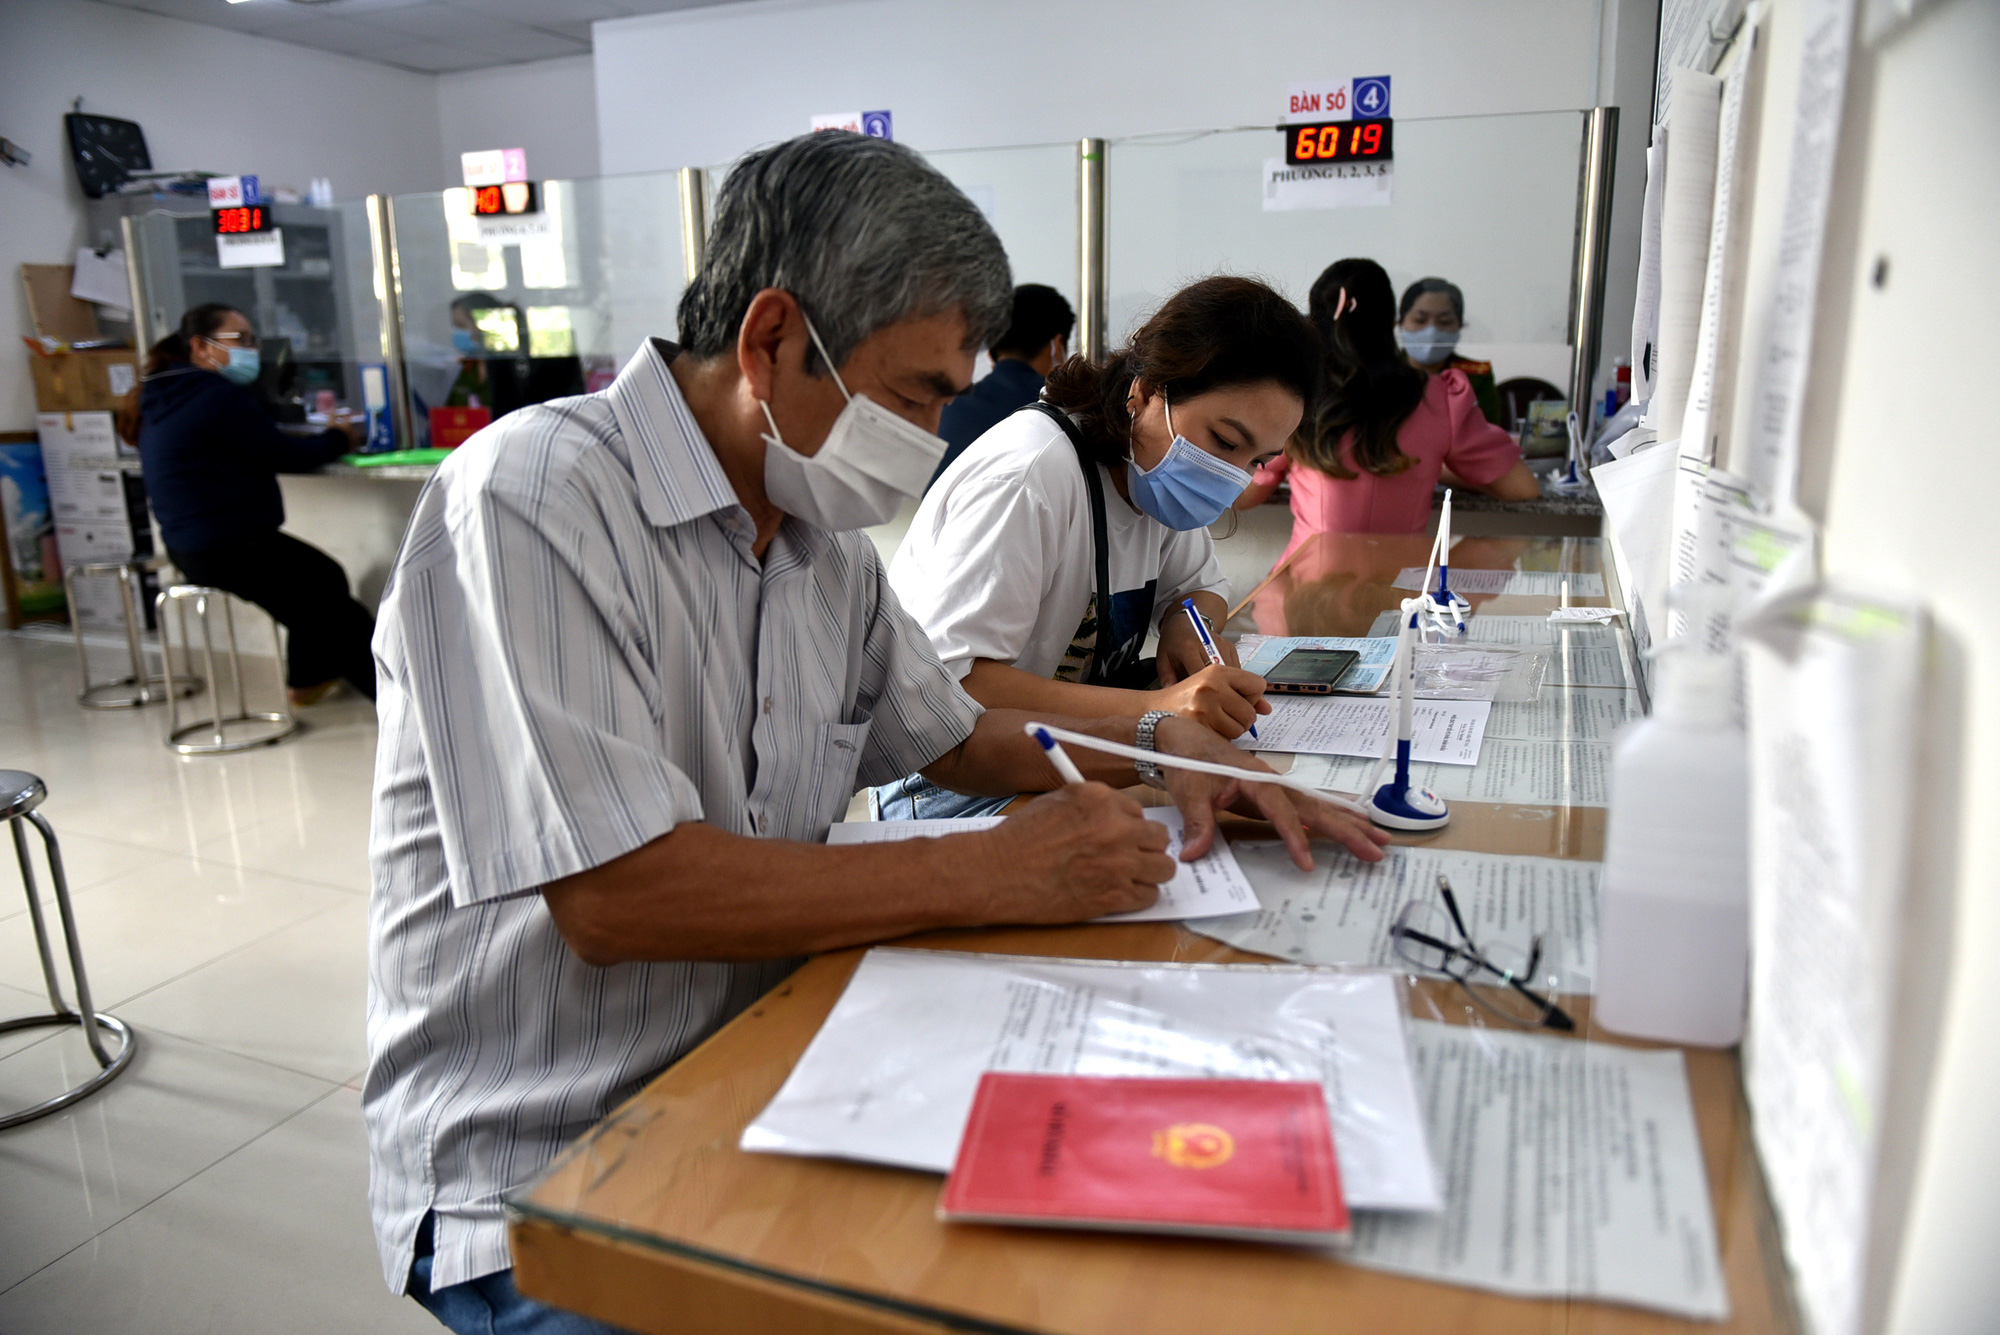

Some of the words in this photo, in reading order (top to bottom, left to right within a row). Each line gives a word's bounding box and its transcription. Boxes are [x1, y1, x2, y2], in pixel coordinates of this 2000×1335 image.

[1289, 90, 1320, 114] BÀN
[1326, 85, 1346, 111] SỐ
[1362, 85, 1380, 109] 4
